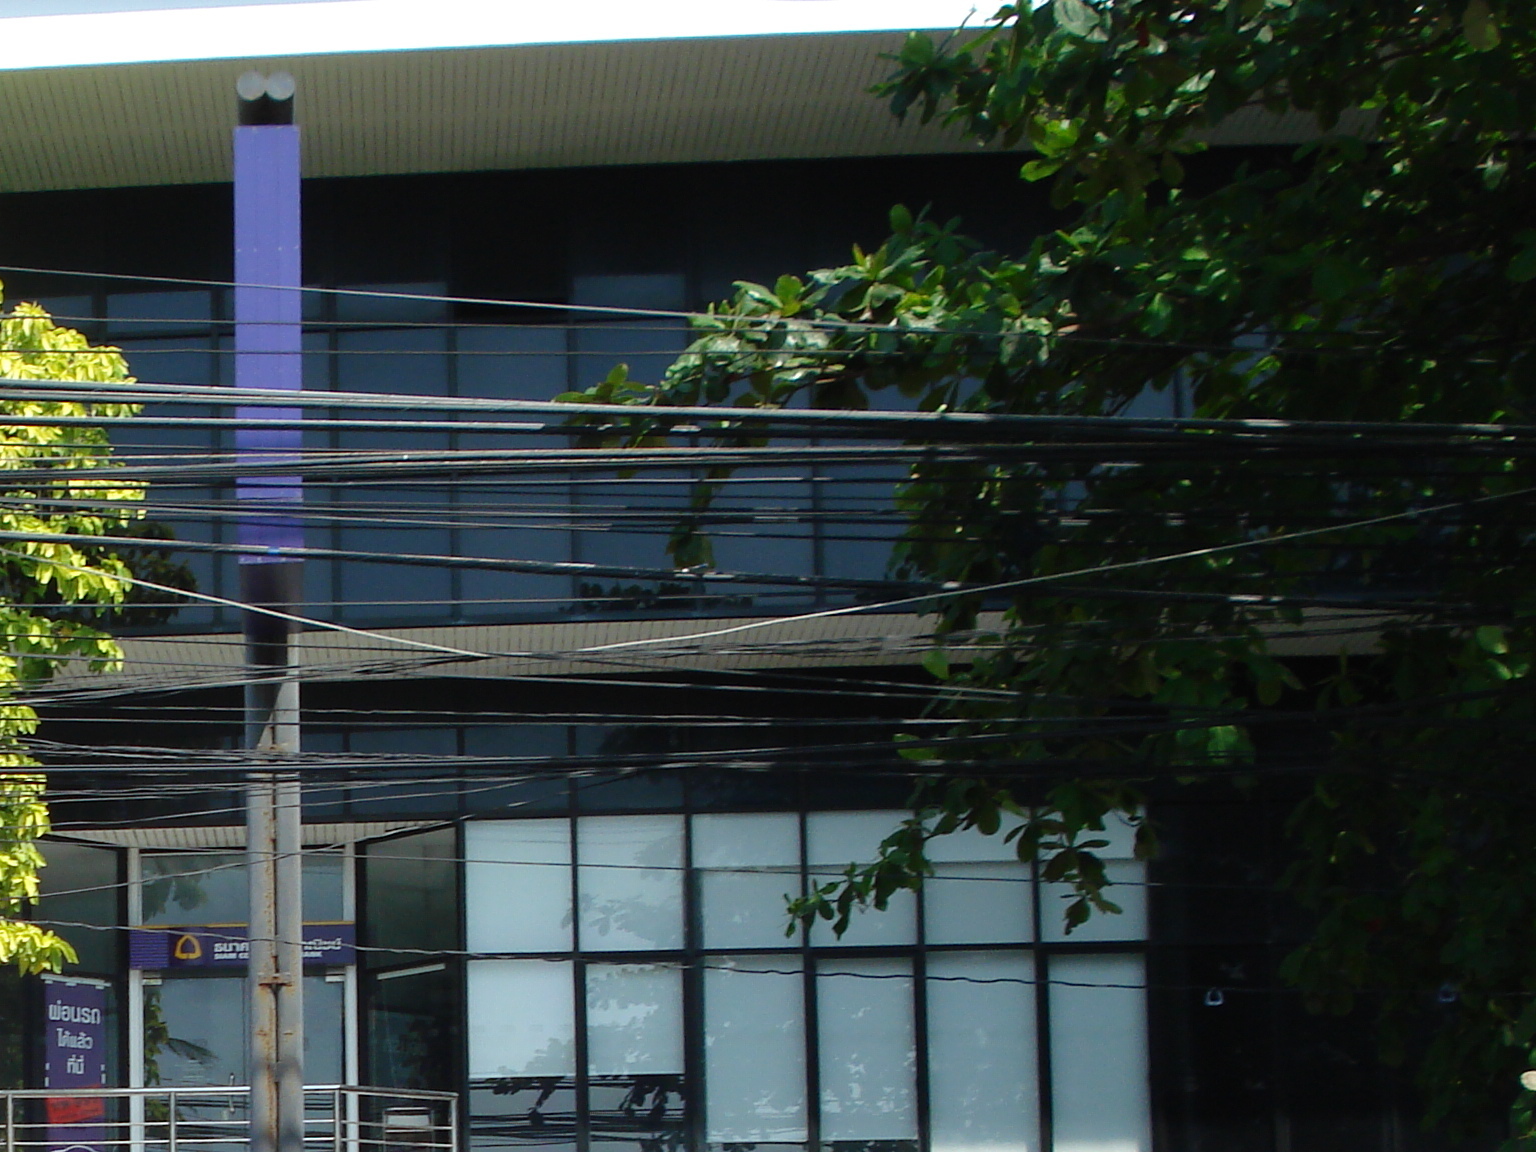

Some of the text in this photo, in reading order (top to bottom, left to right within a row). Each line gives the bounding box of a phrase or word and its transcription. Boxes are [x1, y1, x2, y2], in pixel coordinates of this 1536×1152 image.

[48, 1000, 101, 1025] ผ่อนรถ
[56, 1028, 94, 1049] ได้แล้ว
